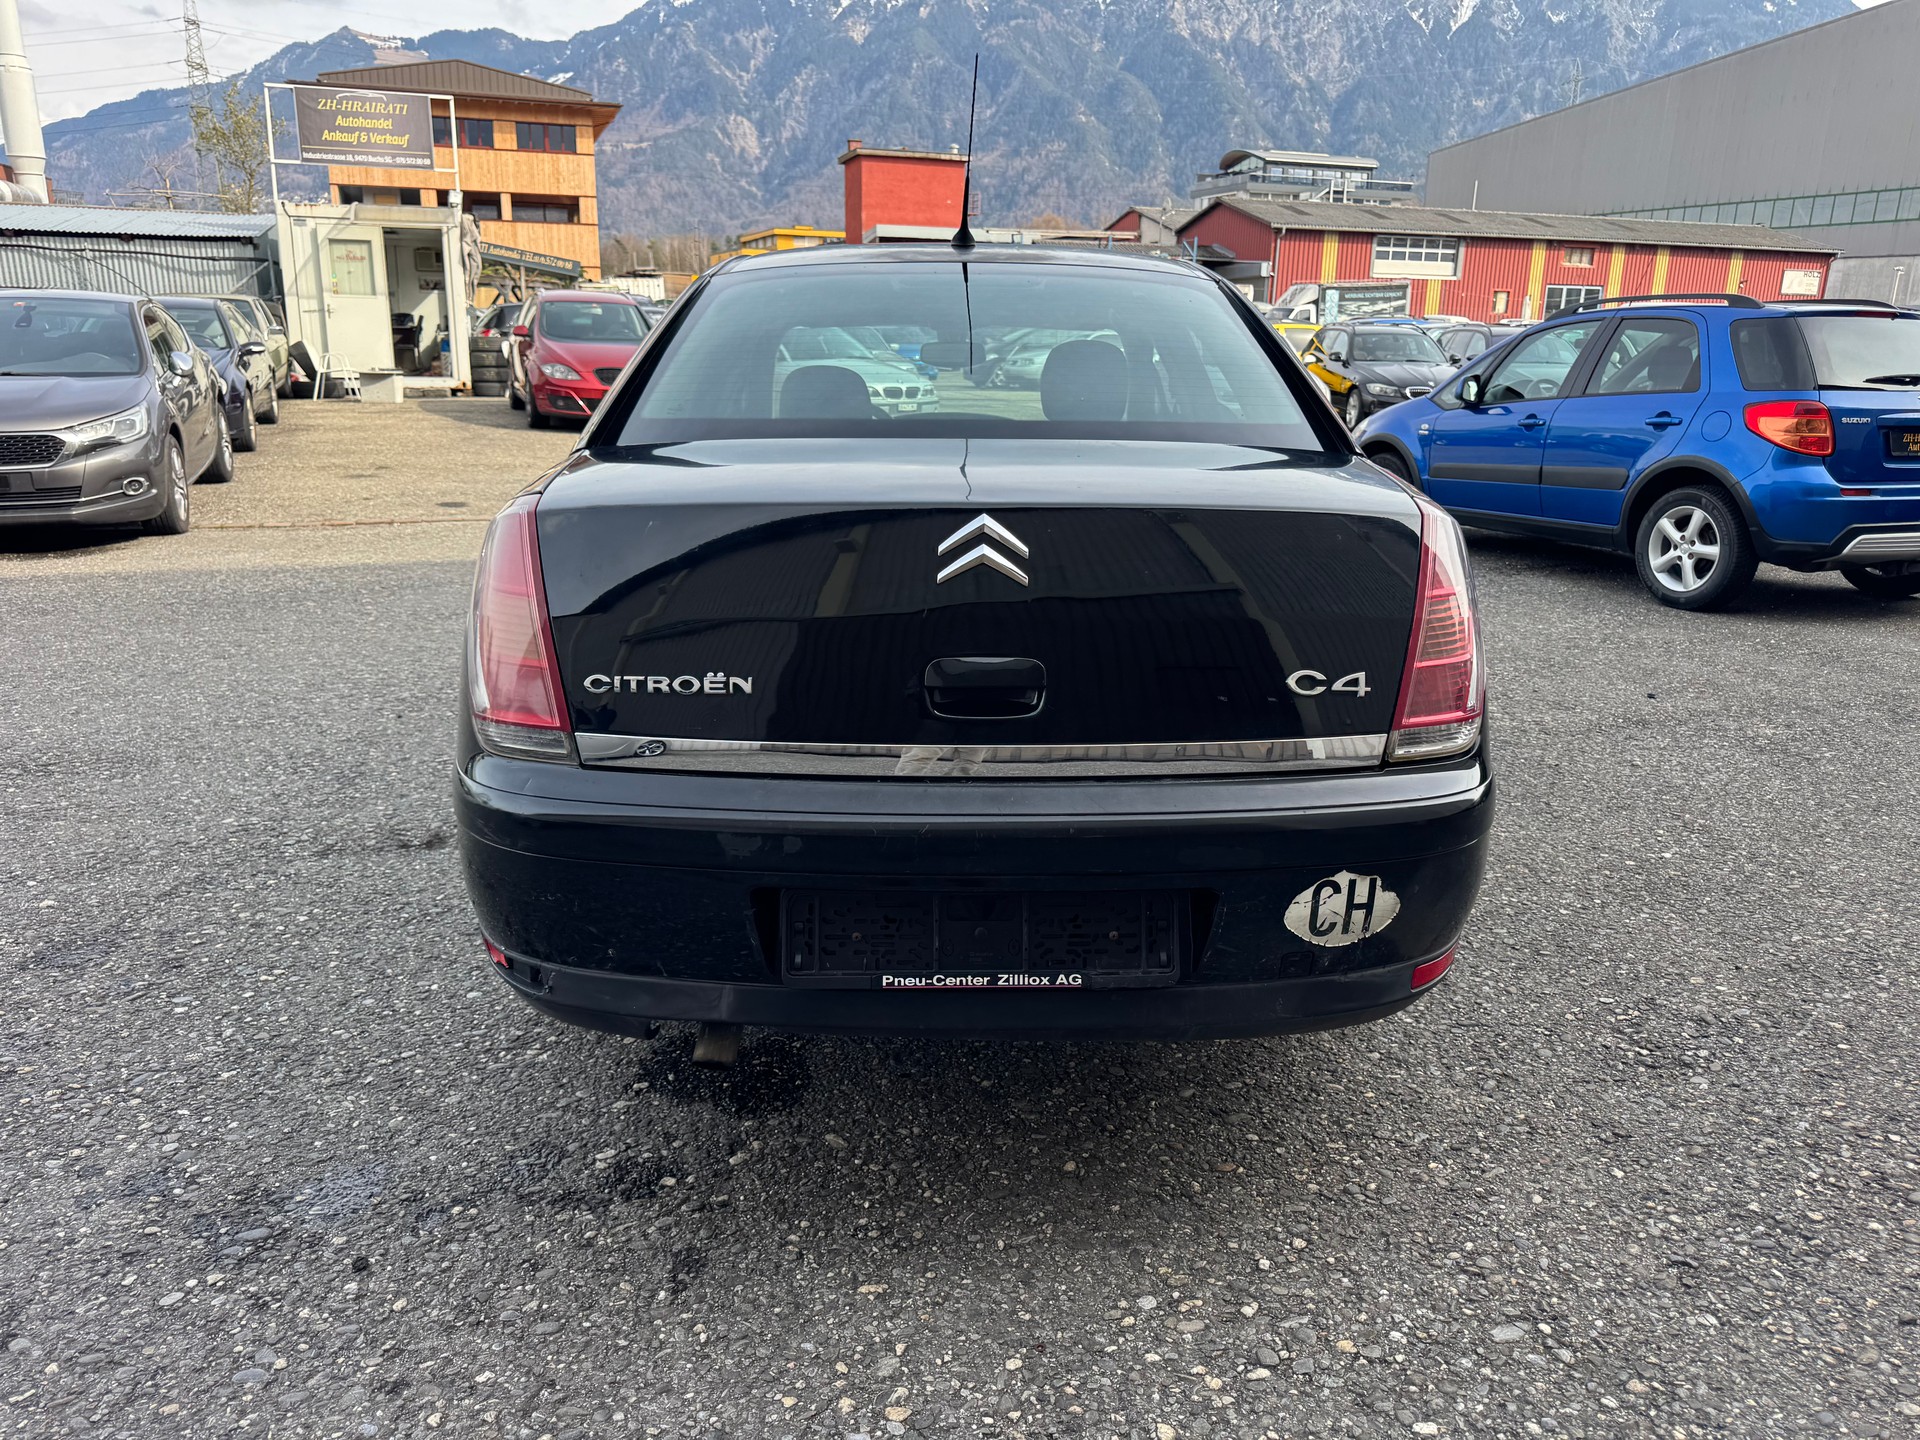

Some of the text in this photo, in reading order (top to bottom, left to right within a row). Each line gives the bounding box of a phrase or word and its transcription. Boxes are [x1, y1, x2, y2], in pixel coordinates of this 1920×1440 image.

[317, 98, 408, 114] ZH-HRAIRATI
[335, 115, 393, 129] Autohandel
[322, 129, 410, 148] Ankauf & Verkauf
[1803, 270, 1821, 278] HOLZ
[583, 672, 753, 695] CITROËN
[1285, 670, 1371, 697] C4
[1308, 877, 1378, 938] CH
[882, 974, 1082, 987] Pneu-Center Zilliox AG
